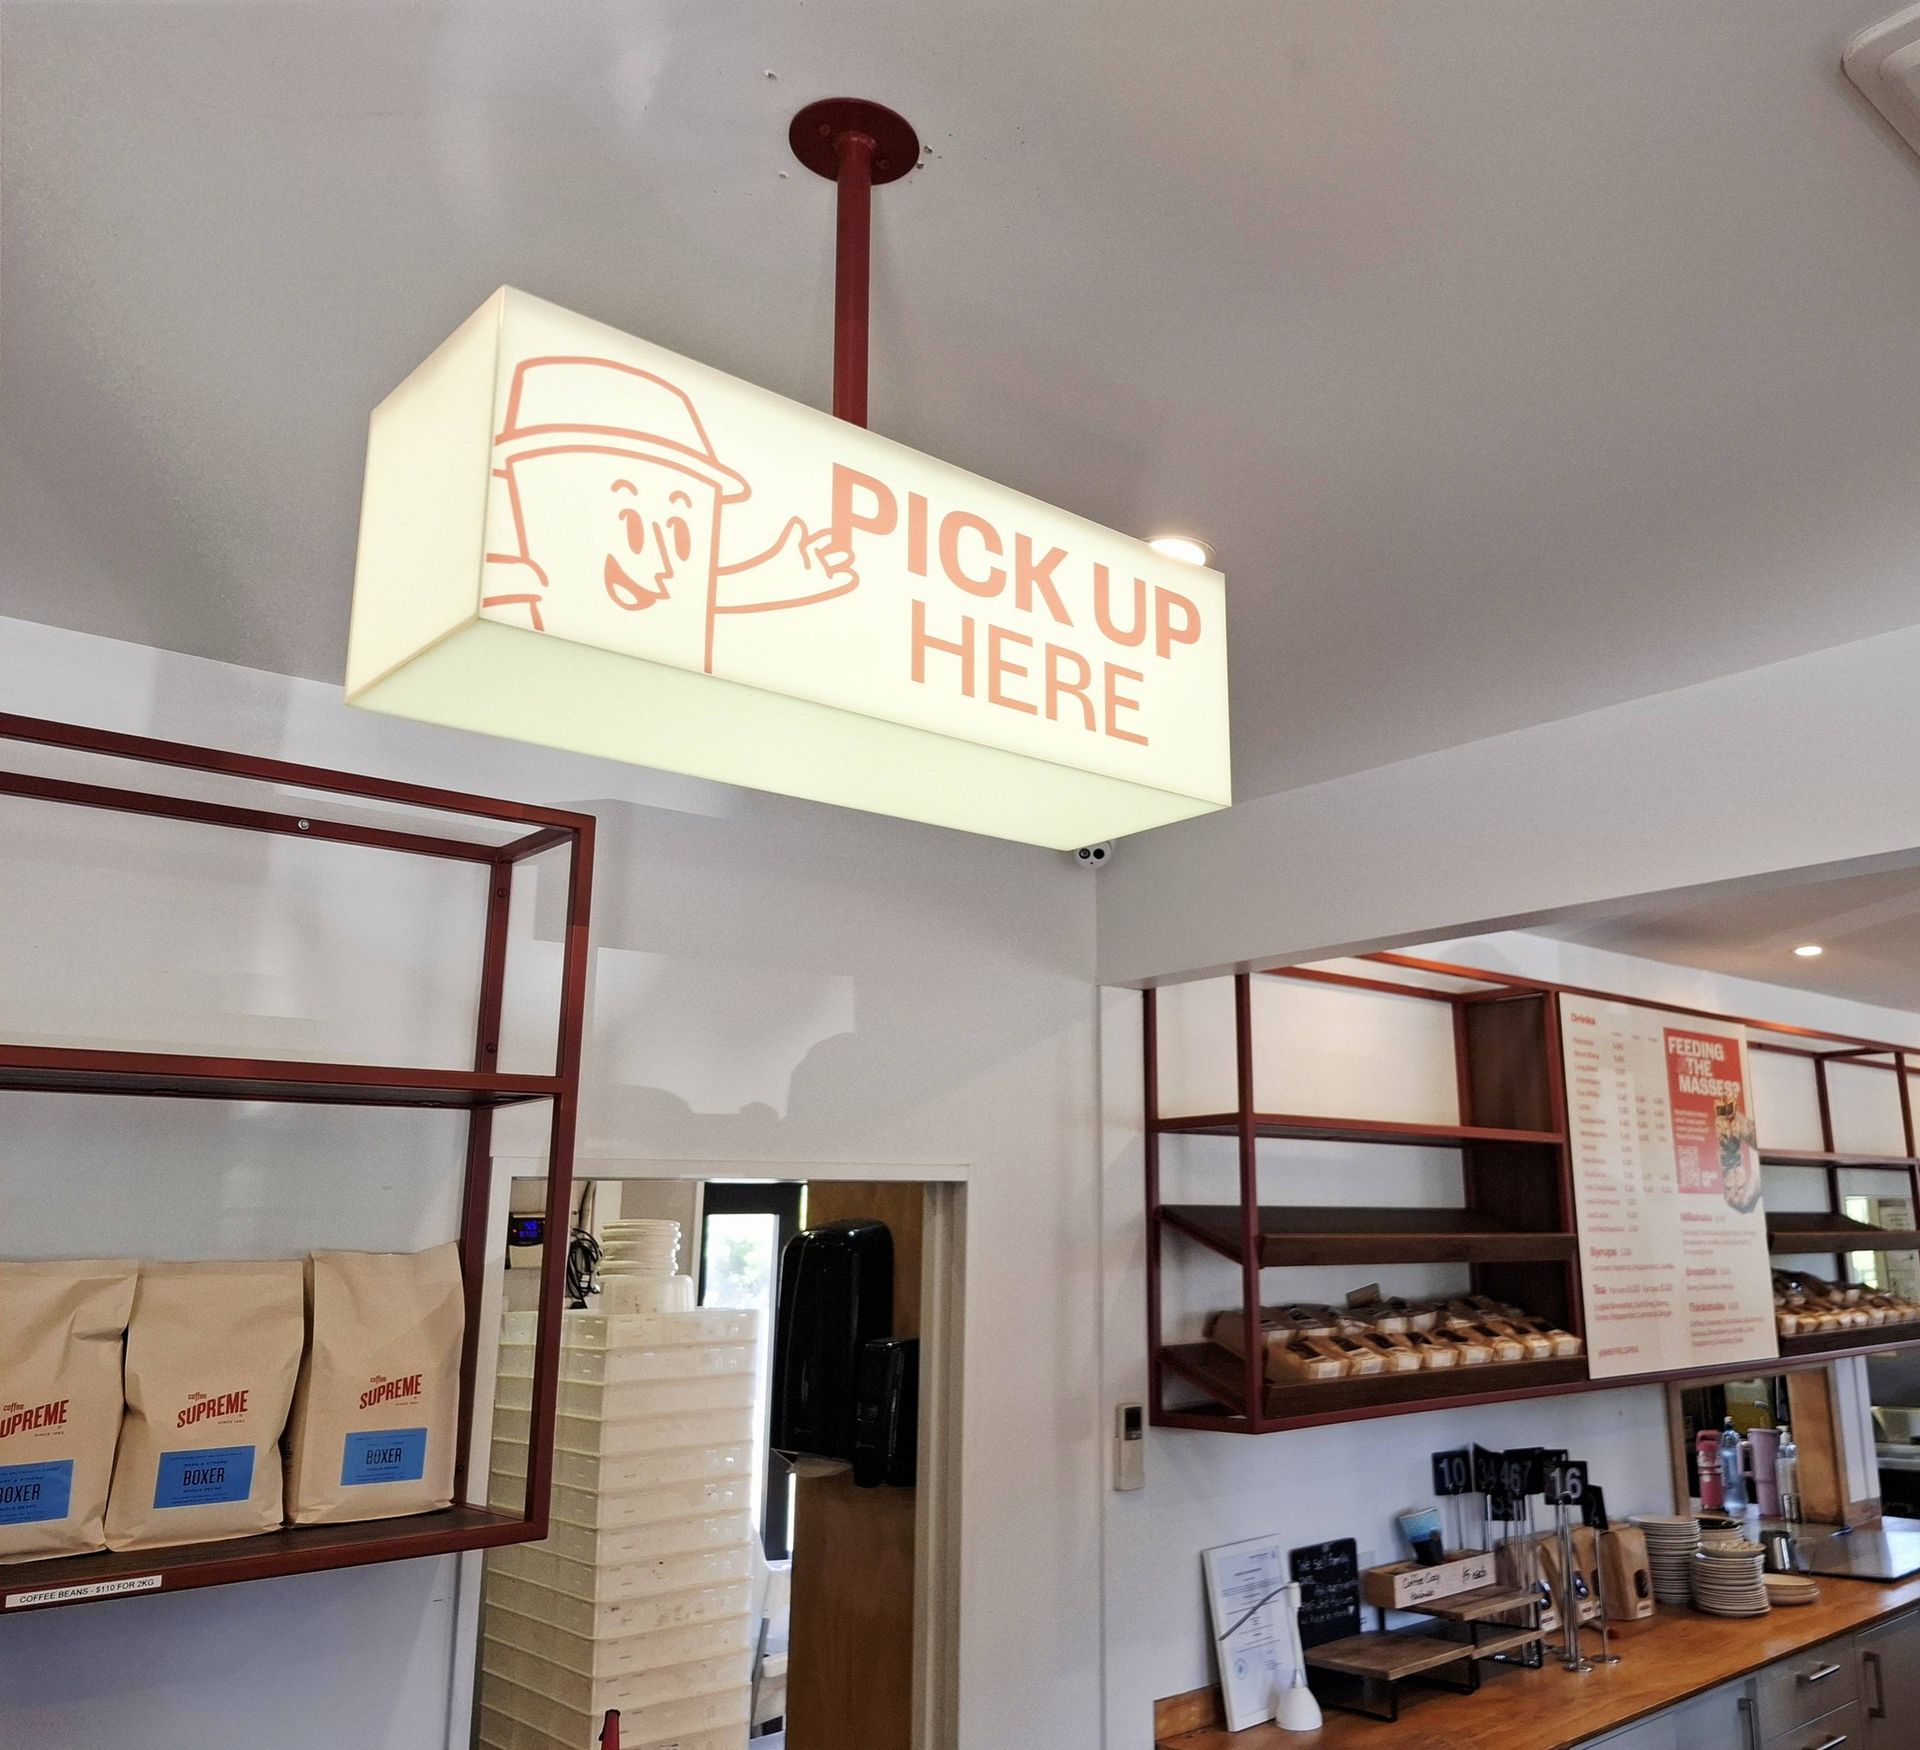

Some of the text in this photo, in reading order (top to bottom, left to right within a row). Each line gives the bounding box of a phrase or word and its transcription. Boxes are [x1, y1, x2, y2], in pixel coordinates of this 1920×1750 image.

[832, 462, 1201, 660] PICK UP
[911, 598, 1149, 746] HERE
[1667, 1036, 1725, 1062] FEEDING
[1686, 1057, 1713, 1077] THE
[1678, 1074, 1740, 1099] MASSES?
[359, 1374, 423, 1410] SUPREME
[0, 1399, 70, 1439] UPREME
[176, 1390, 249, 1429] SUPREME
[366, 1447, 402, 1465] BOXER
[183, 1467, 225, 1487] BOXER
[1439, 1457, 1467, 1488] 10
[1551, 1467, 1582, 1499] 16
[19, 1591, 57, 1604] COFFEE
[58, 1587, 89, 1599] BEANS
[95, 1585, 115, 1595] $110
[116, 1582, 135, 1591] FOR
[136, 1578, 155, 1588] 2KG
